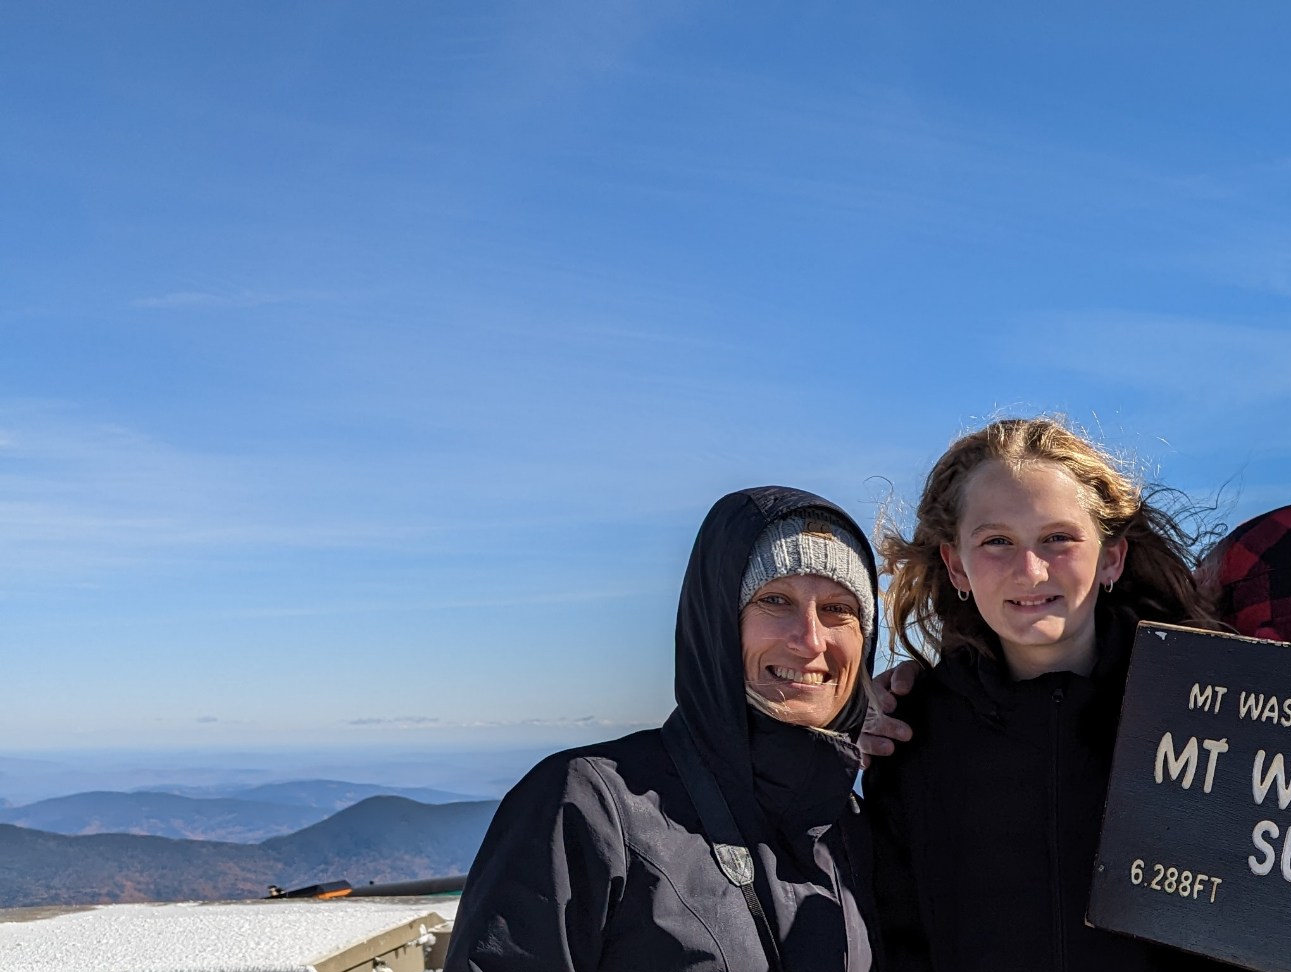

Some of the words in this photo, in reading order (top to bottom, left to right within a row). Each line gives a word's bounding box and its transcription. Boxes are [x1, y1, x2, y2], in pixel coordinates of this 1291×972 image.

[1188, 682, 1228, 714] MT
[1153, 730, 1229, 794] MT
[1129, 858, 1223, 904] 6.288FT
